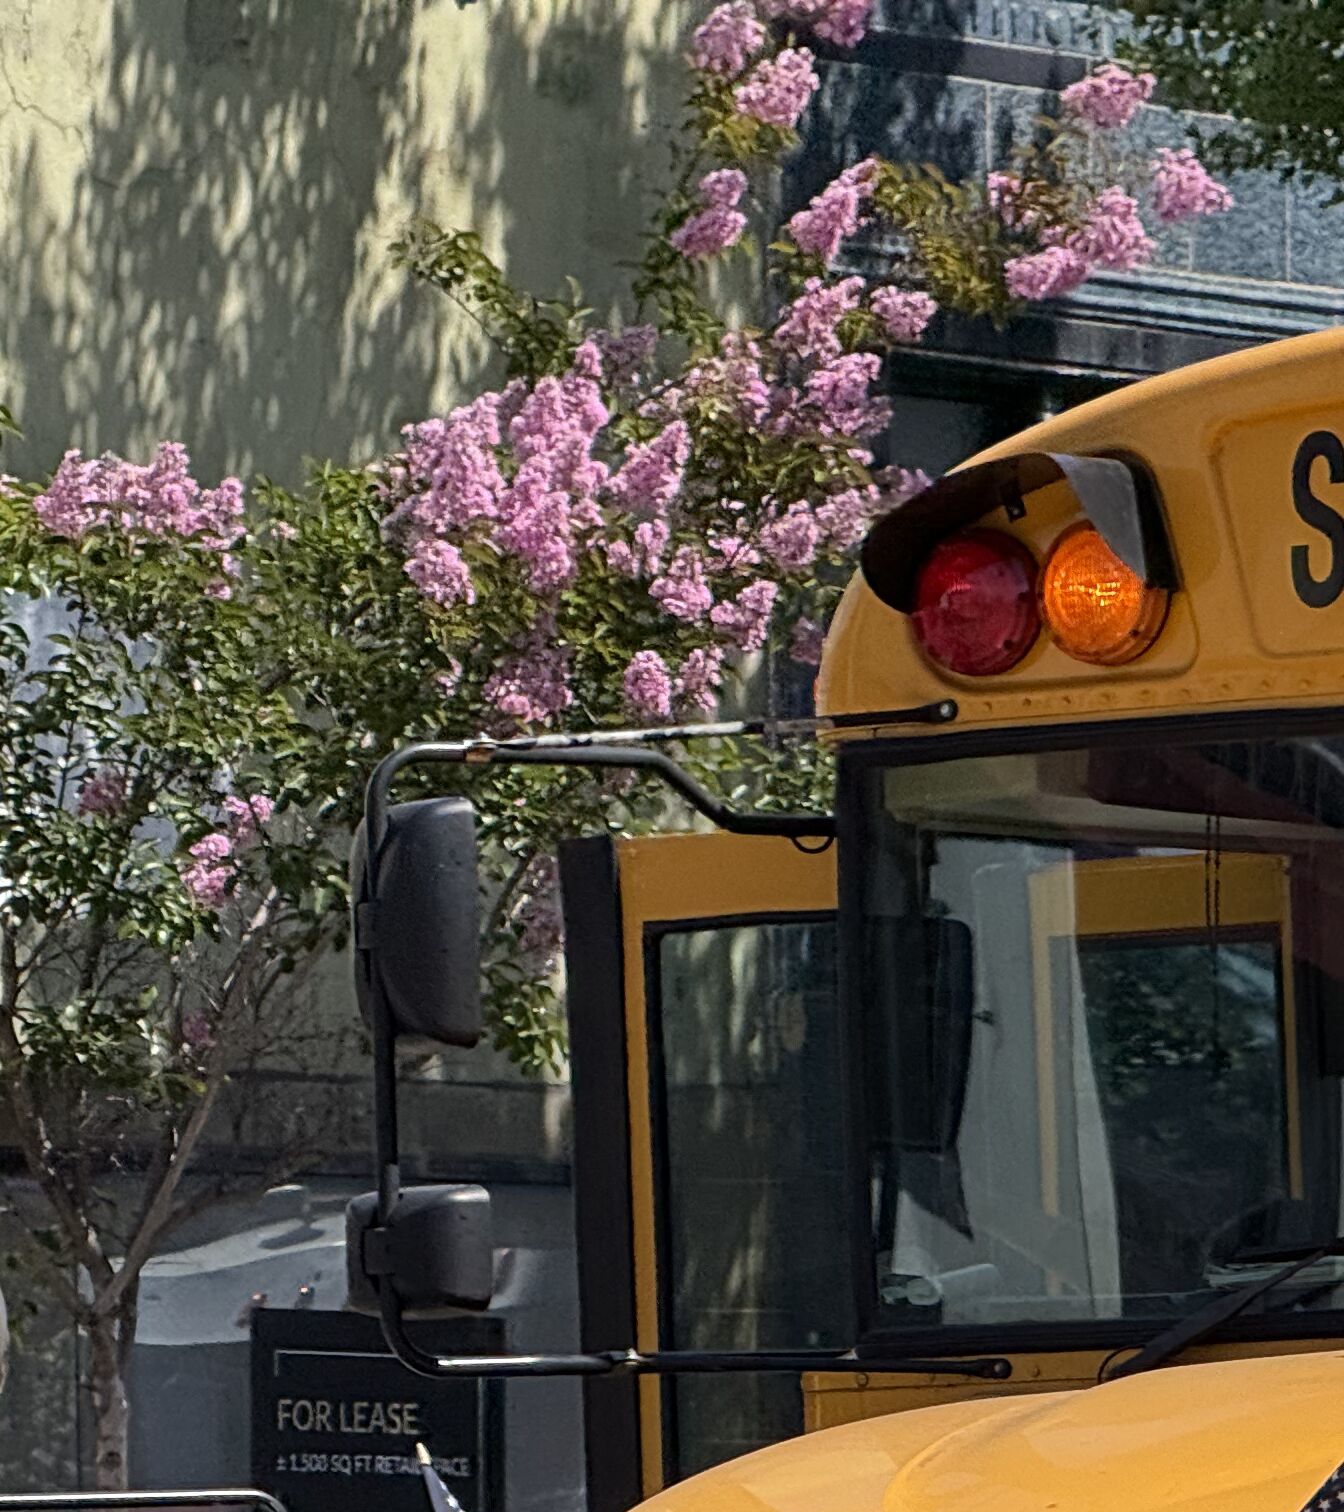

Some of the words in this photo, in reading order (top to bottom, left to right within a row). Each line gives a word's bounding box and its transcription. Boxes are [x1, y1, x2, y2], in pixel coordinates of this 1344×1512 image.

[277, 1399, 333, 1431] FOR
[340, 1402, 421, 1435] LEASE
[331, 1454, 351, 1475] SQ
[354, 1455, 372, 1472] FT
